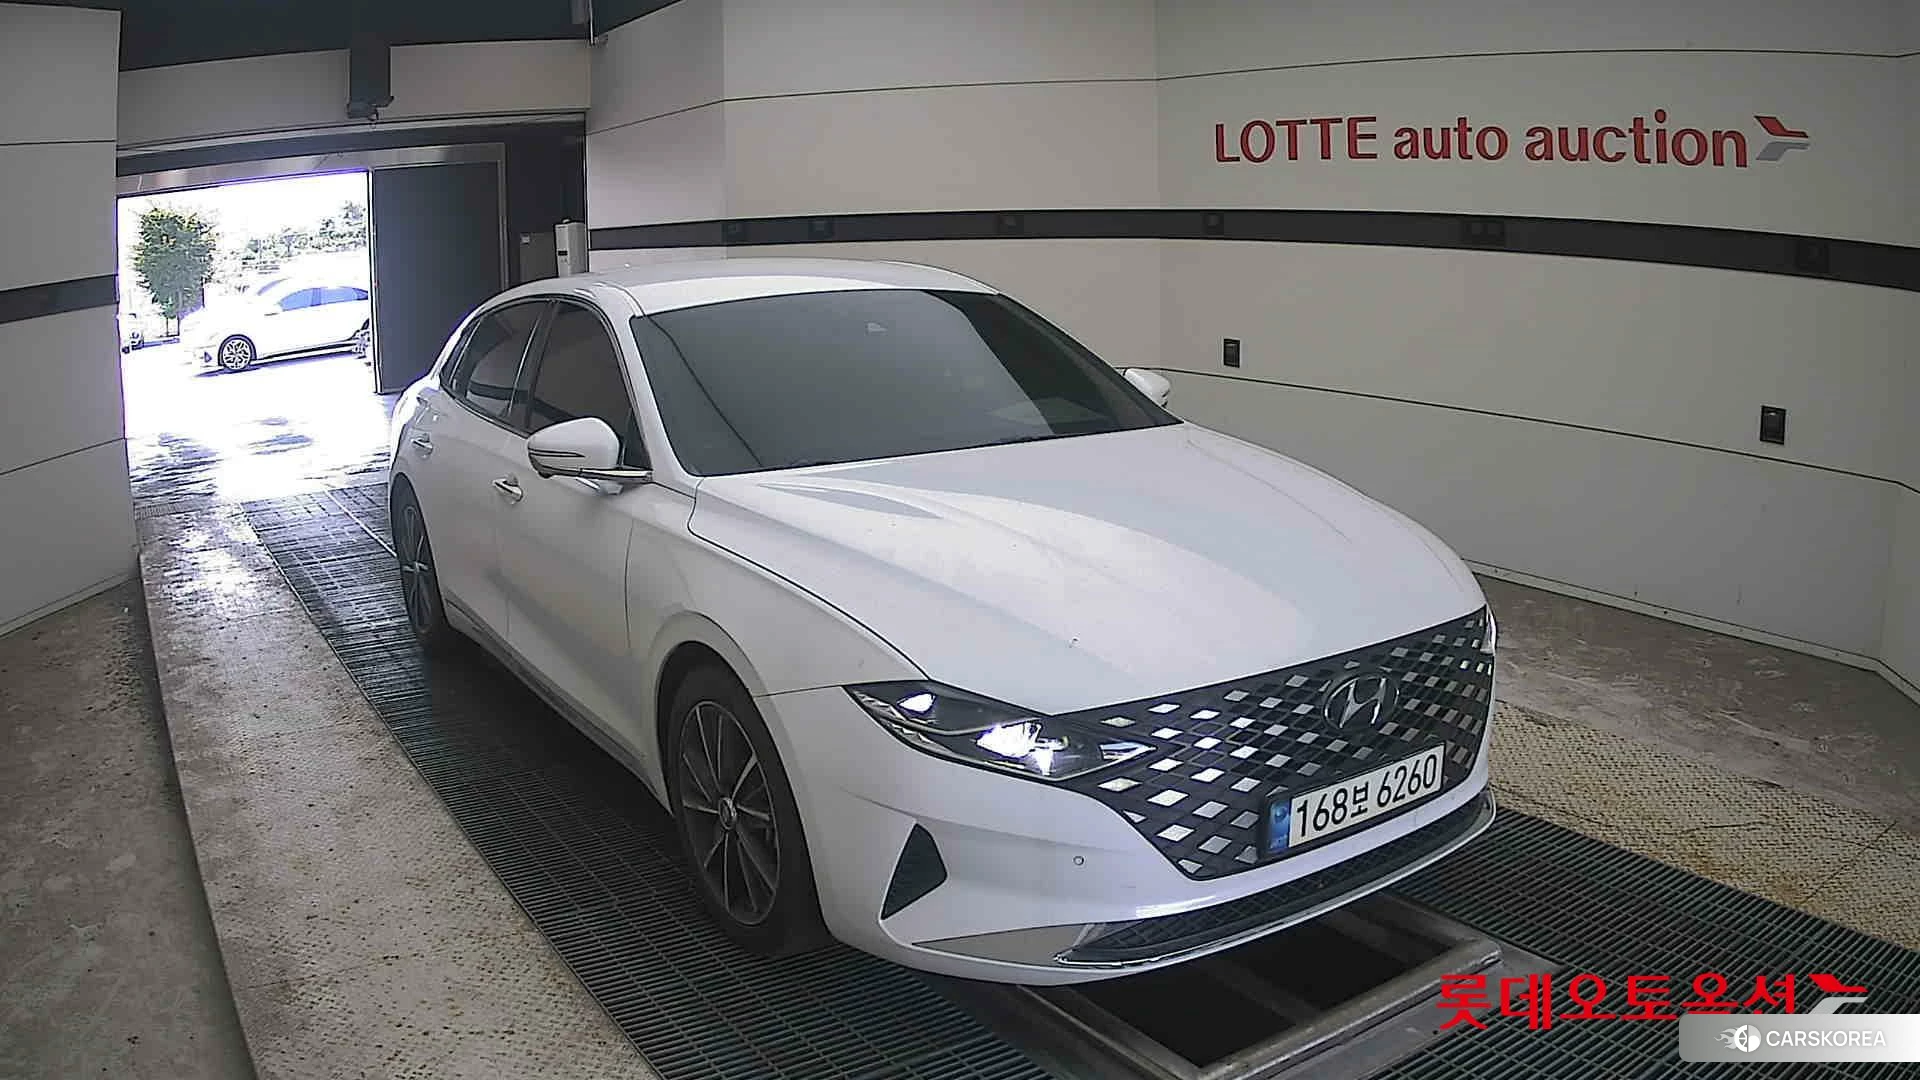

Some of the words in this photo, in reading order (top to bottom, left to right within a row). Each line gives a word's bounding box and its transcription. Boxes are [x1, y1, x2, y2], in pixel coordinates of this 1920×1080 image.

[1215, 116, 1377, 163] LOTTE
[1394, 116, 1508, 161] auto
[1525, 108, 1747, 169] auction
[1297, 782, 1369, 837] 168보
[1377, 754, 1437, 807] 6260
